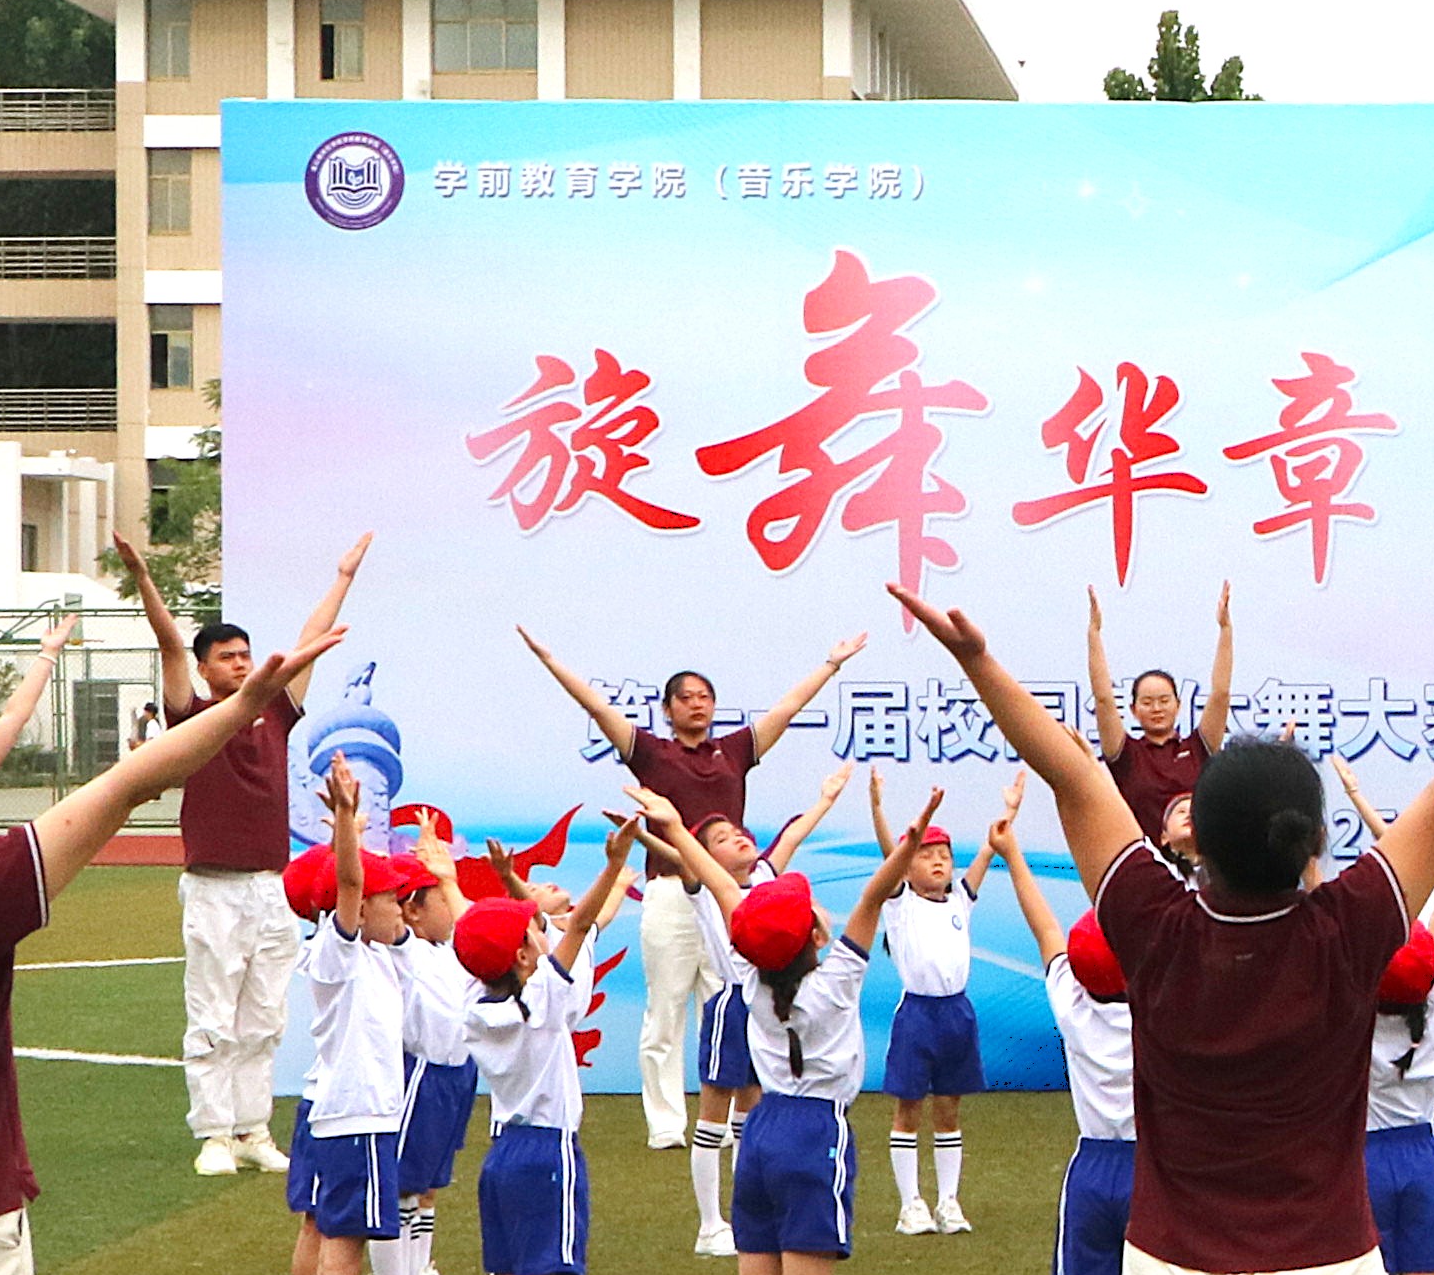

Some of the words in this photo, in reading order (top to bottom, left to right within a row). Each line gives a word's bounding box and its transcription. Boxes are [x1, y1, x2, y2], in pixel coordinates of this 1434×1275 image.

[433, 161, 927, 200] 学前教育学院（音乐学院）
